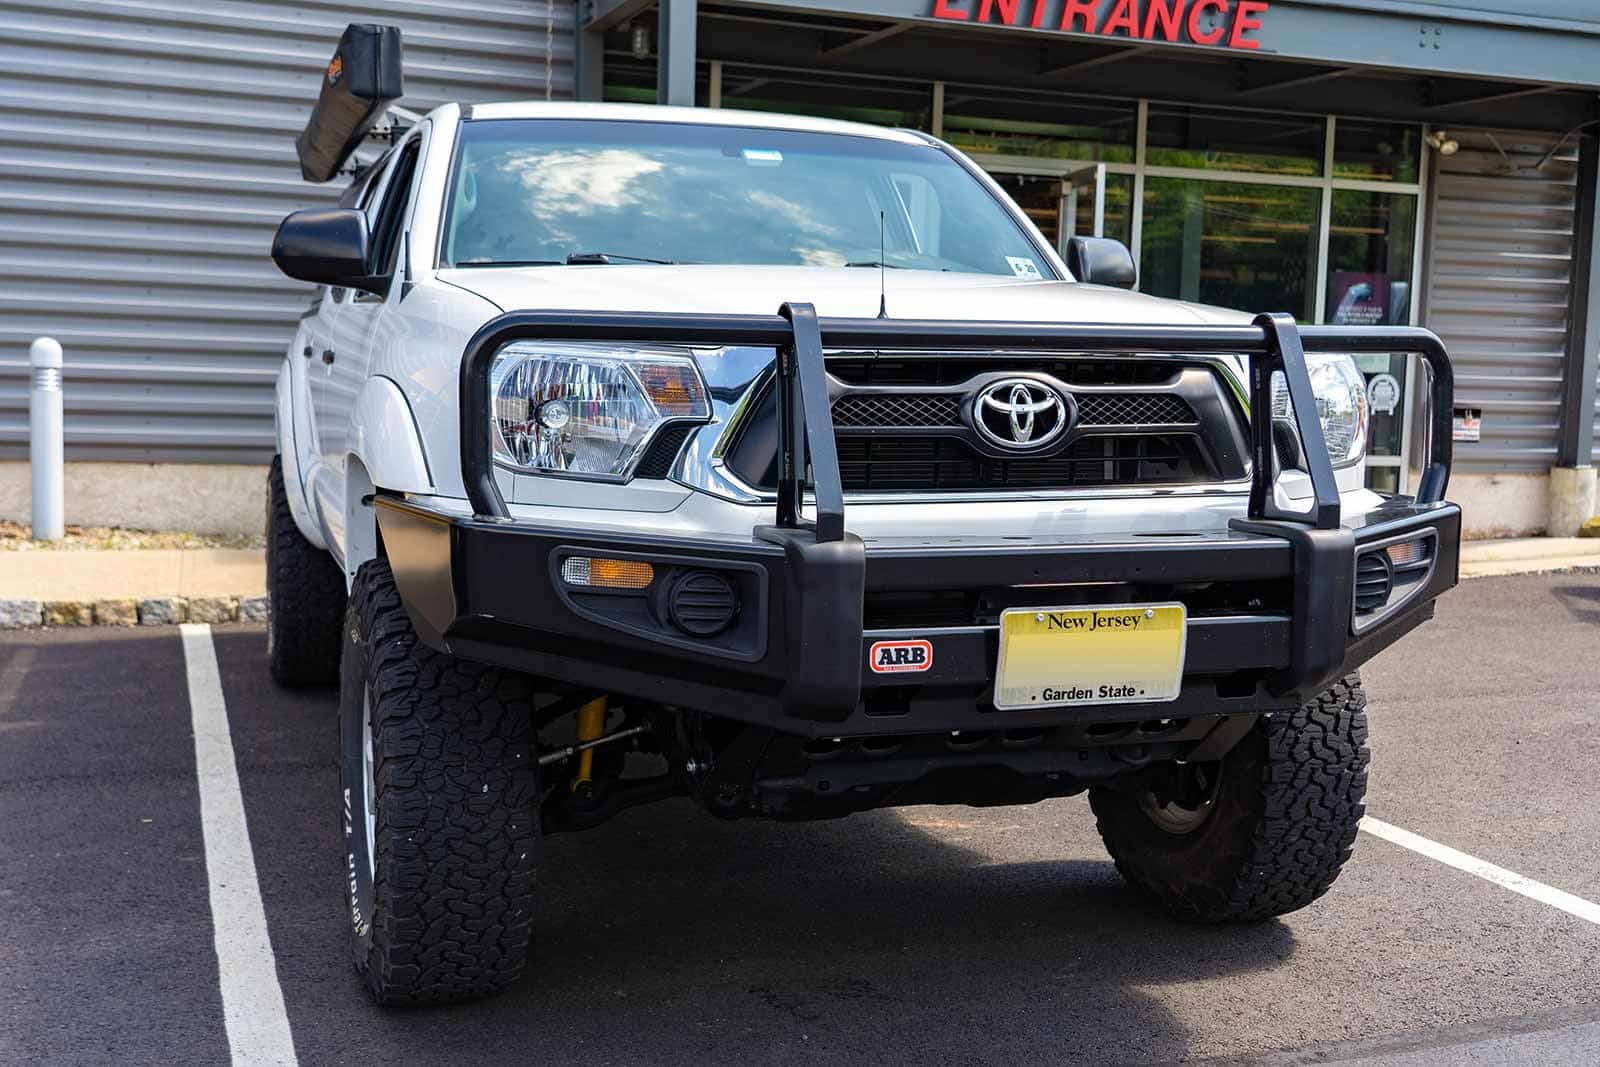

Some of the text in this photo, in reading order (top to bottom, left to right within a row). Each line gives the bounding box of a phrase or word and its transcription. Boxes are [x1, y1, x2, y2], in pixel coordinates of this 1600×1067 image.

[1047, 611, 1141, 631] New Jersey
[878, 647, 926, 666] ARB
[1042, 685, 1136, 702] Garden State
